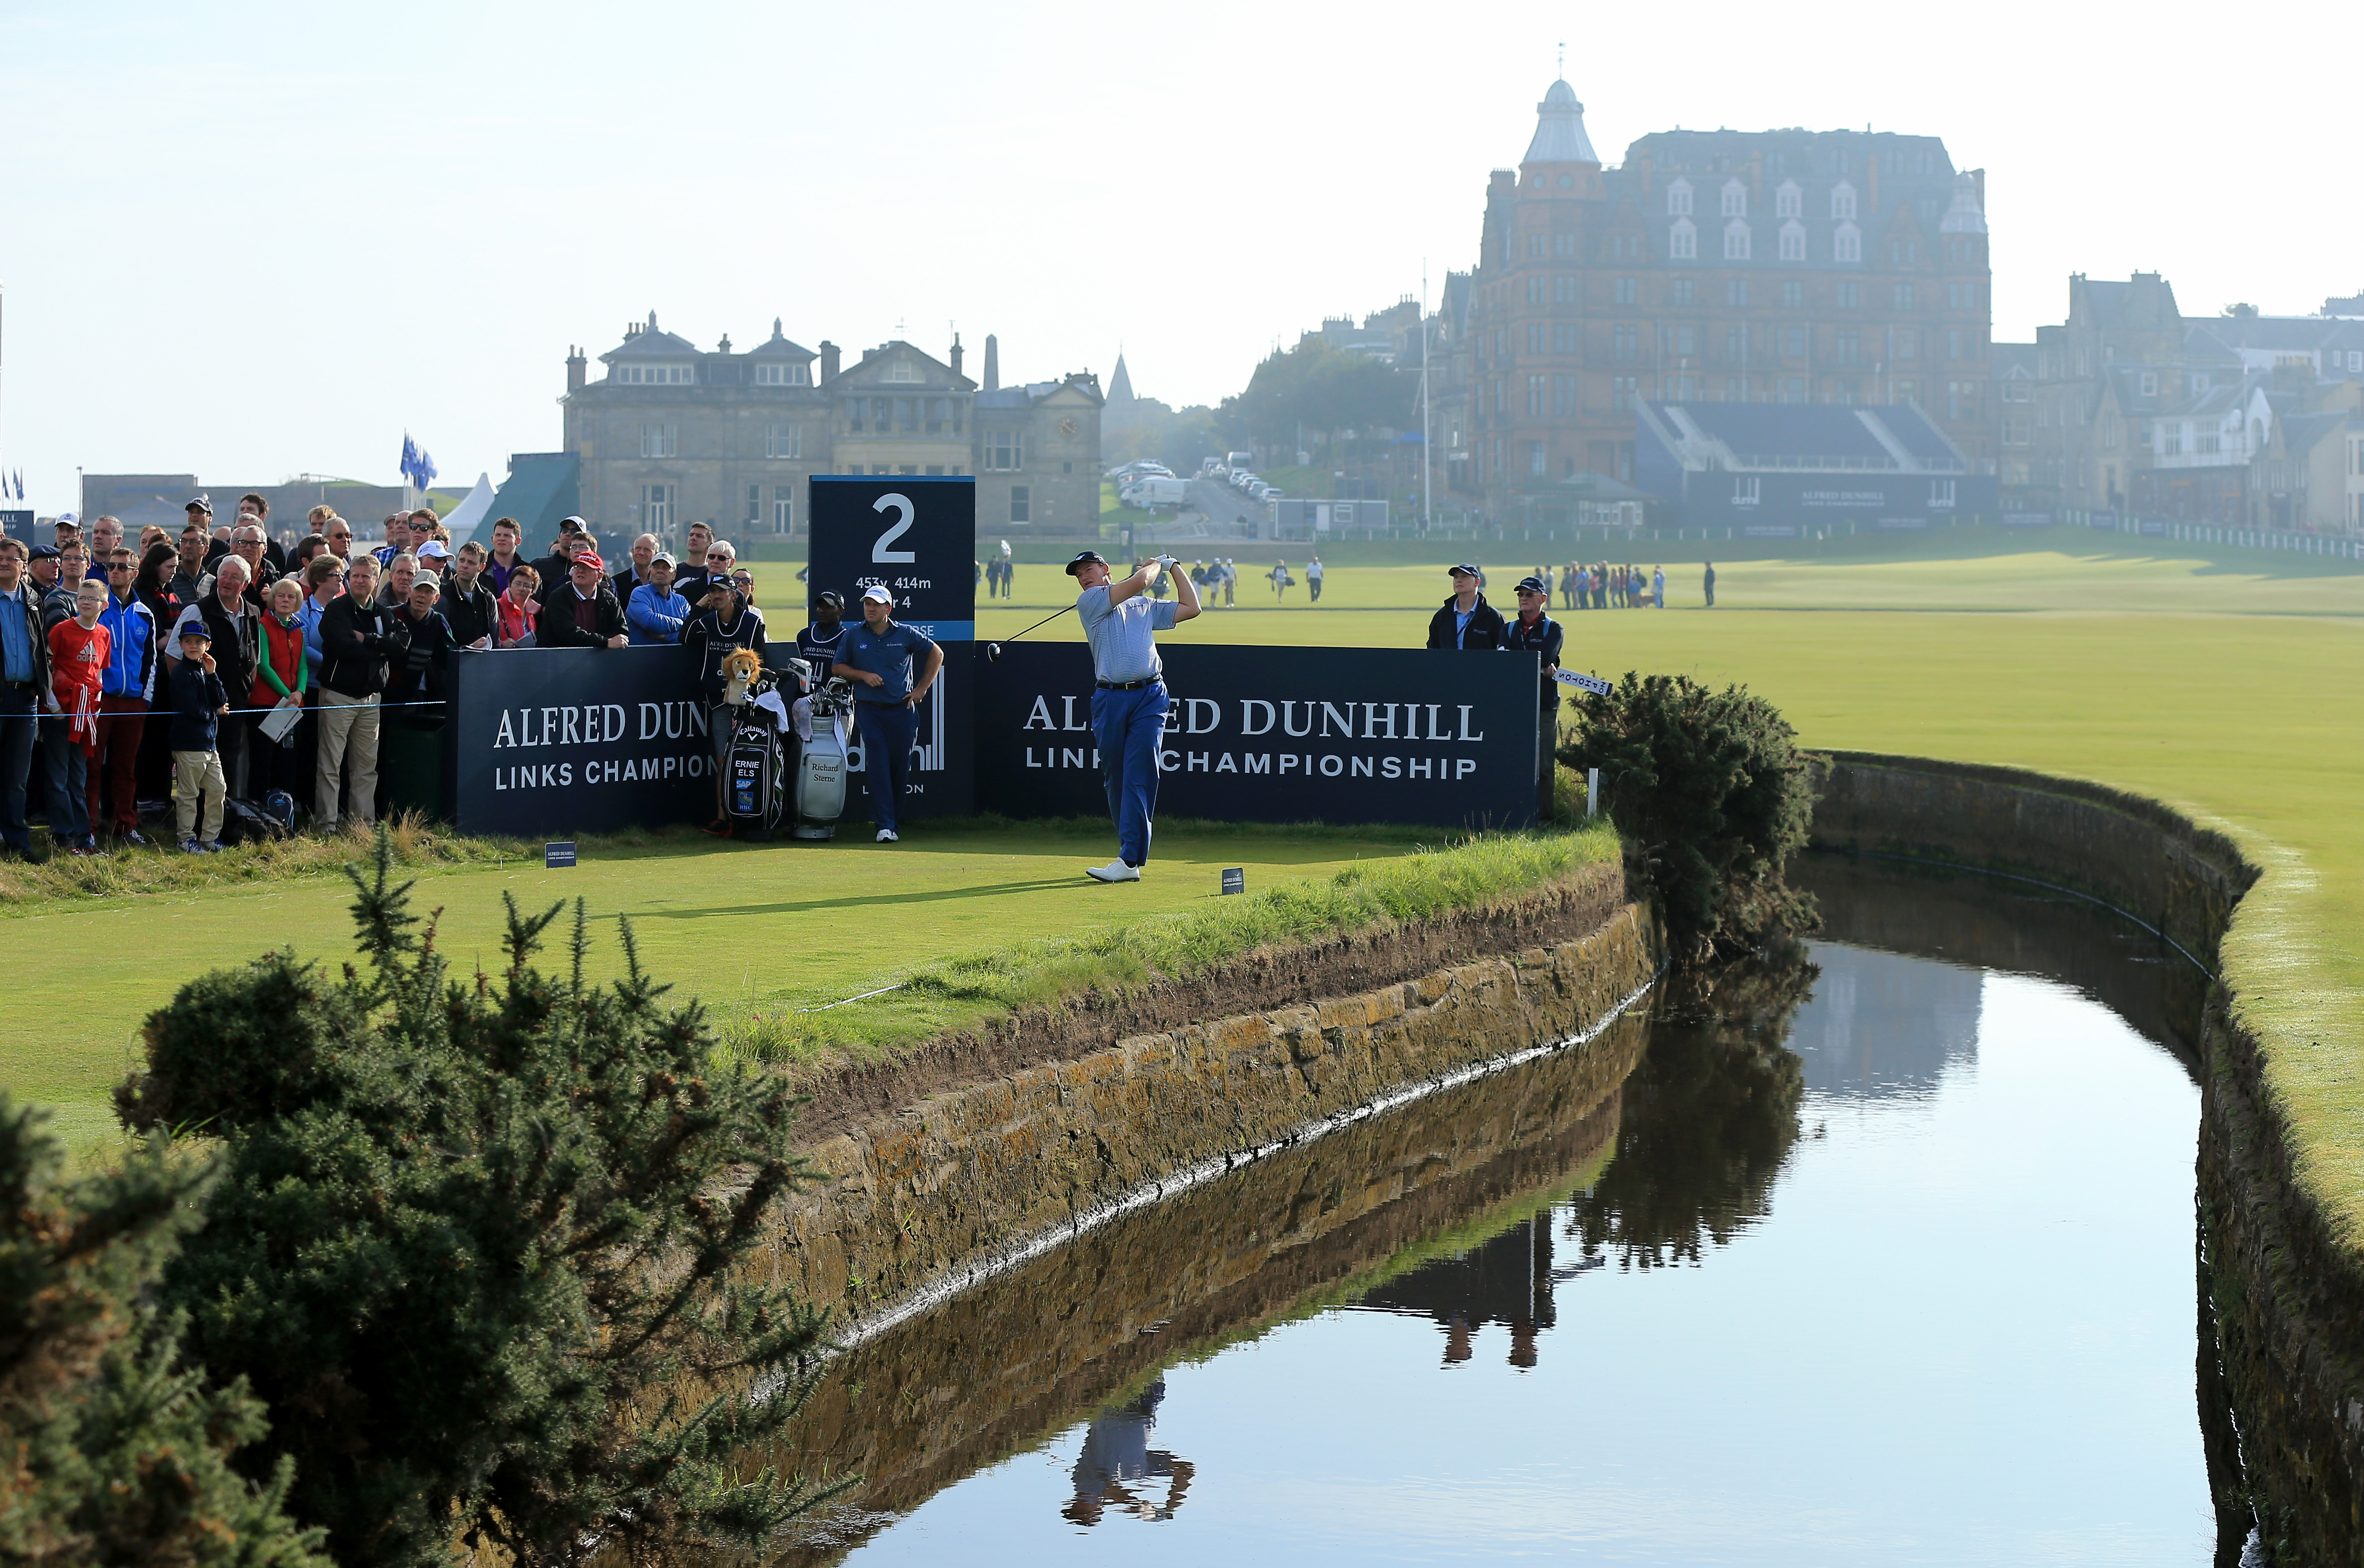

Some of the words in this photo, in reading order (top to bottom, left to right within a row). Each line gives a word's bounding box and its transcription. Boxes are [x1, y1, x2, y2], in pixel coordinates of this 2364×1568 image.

[872, 493, 915, 563] 2
[895, 577, 931, 588] 414m
[902, 596, 911, 608] 4
[1559, 673, 1597, 688] PHOTOS
[1599, 681, 1606, 693] NO
[1023, 695, 1221, 733] ALED
[1240, 699, 1483, 741] DUNHILL
[493, 704, 626, 748] ALFRED
[739, 725, 768, 737] Callaway
[735, 760, 760, 769] ERNIE
[812, 763, 838, 772] Richard
[1026, 747, 1099, 769] LIN
[1159, 750, 1476, 780] CHAMPIONSHIP
[496, 763, 572, 790] LINKS
[585, 755, 718, 784] CHAMPION
[814, 774, 835, 782] Sterne
